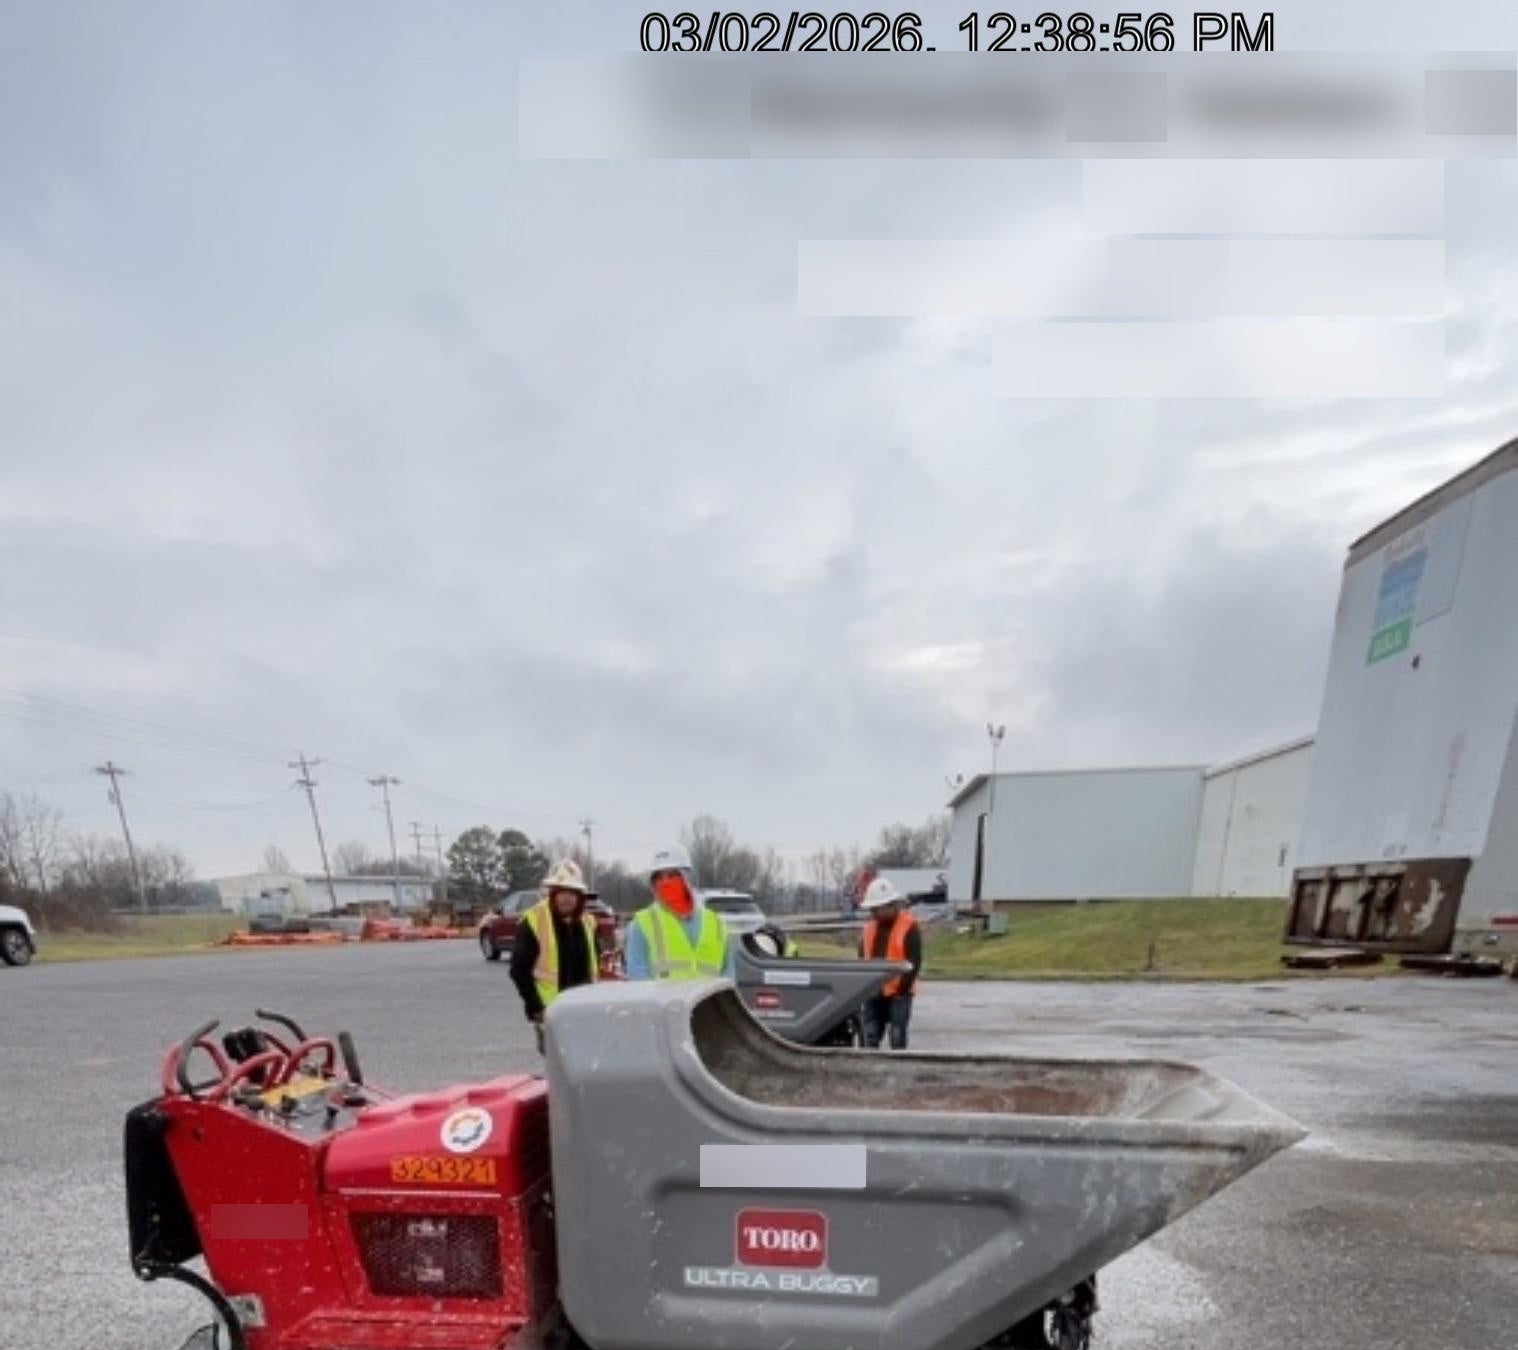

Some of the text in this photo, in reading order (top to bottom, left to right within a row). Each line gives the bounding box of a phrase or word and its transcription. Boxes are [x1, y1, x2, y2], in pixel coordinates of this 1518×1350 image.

[743, 1226, 819, 1251] TORO
[685, 1267, 869, 1294] ULTRA BUGGY
